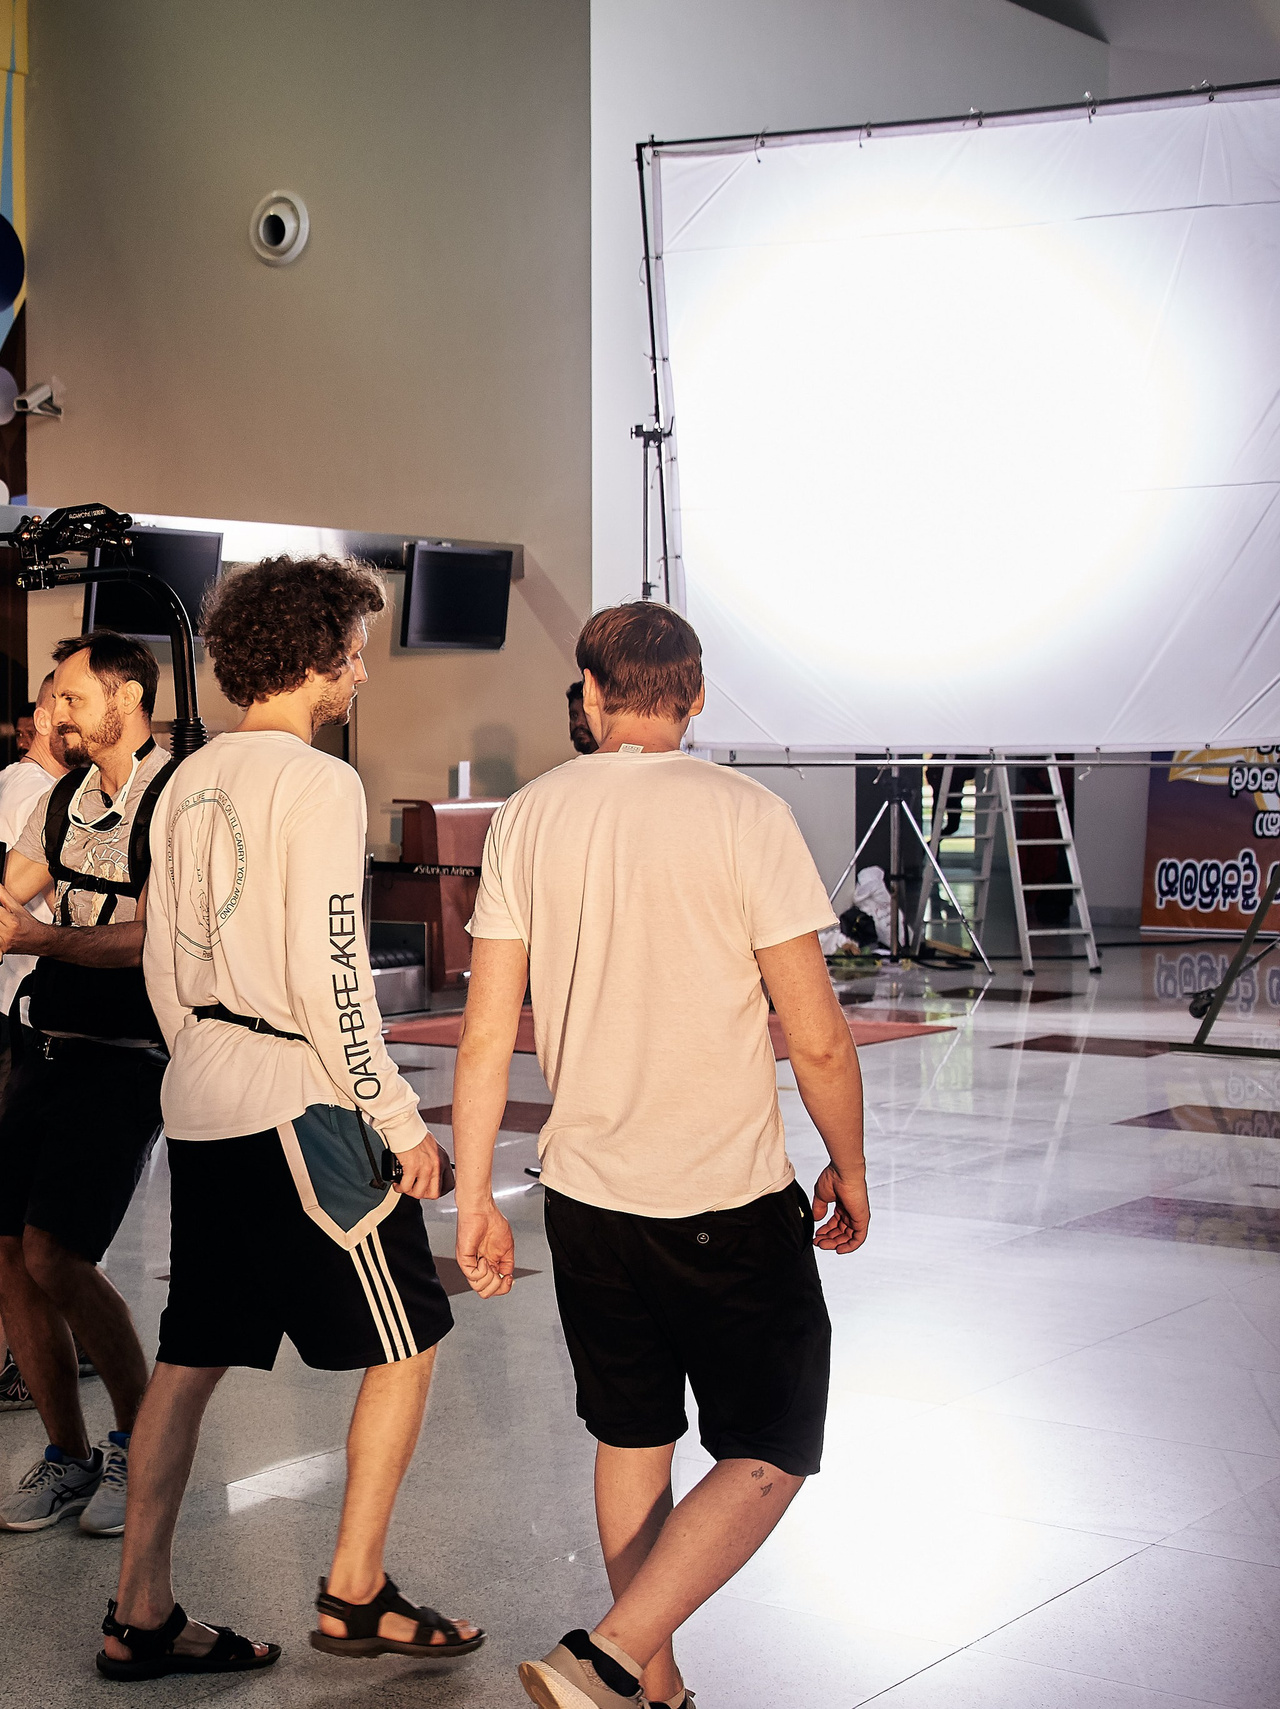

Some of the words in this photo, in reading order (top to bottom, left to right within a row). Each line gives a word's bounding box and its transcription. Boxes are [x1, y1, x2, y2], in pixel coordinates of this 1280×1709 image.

[234, 832, 245, 863] CARRY
[236, 866, 245, 886] YOU
[219, 887, 241, 920] AROUND
